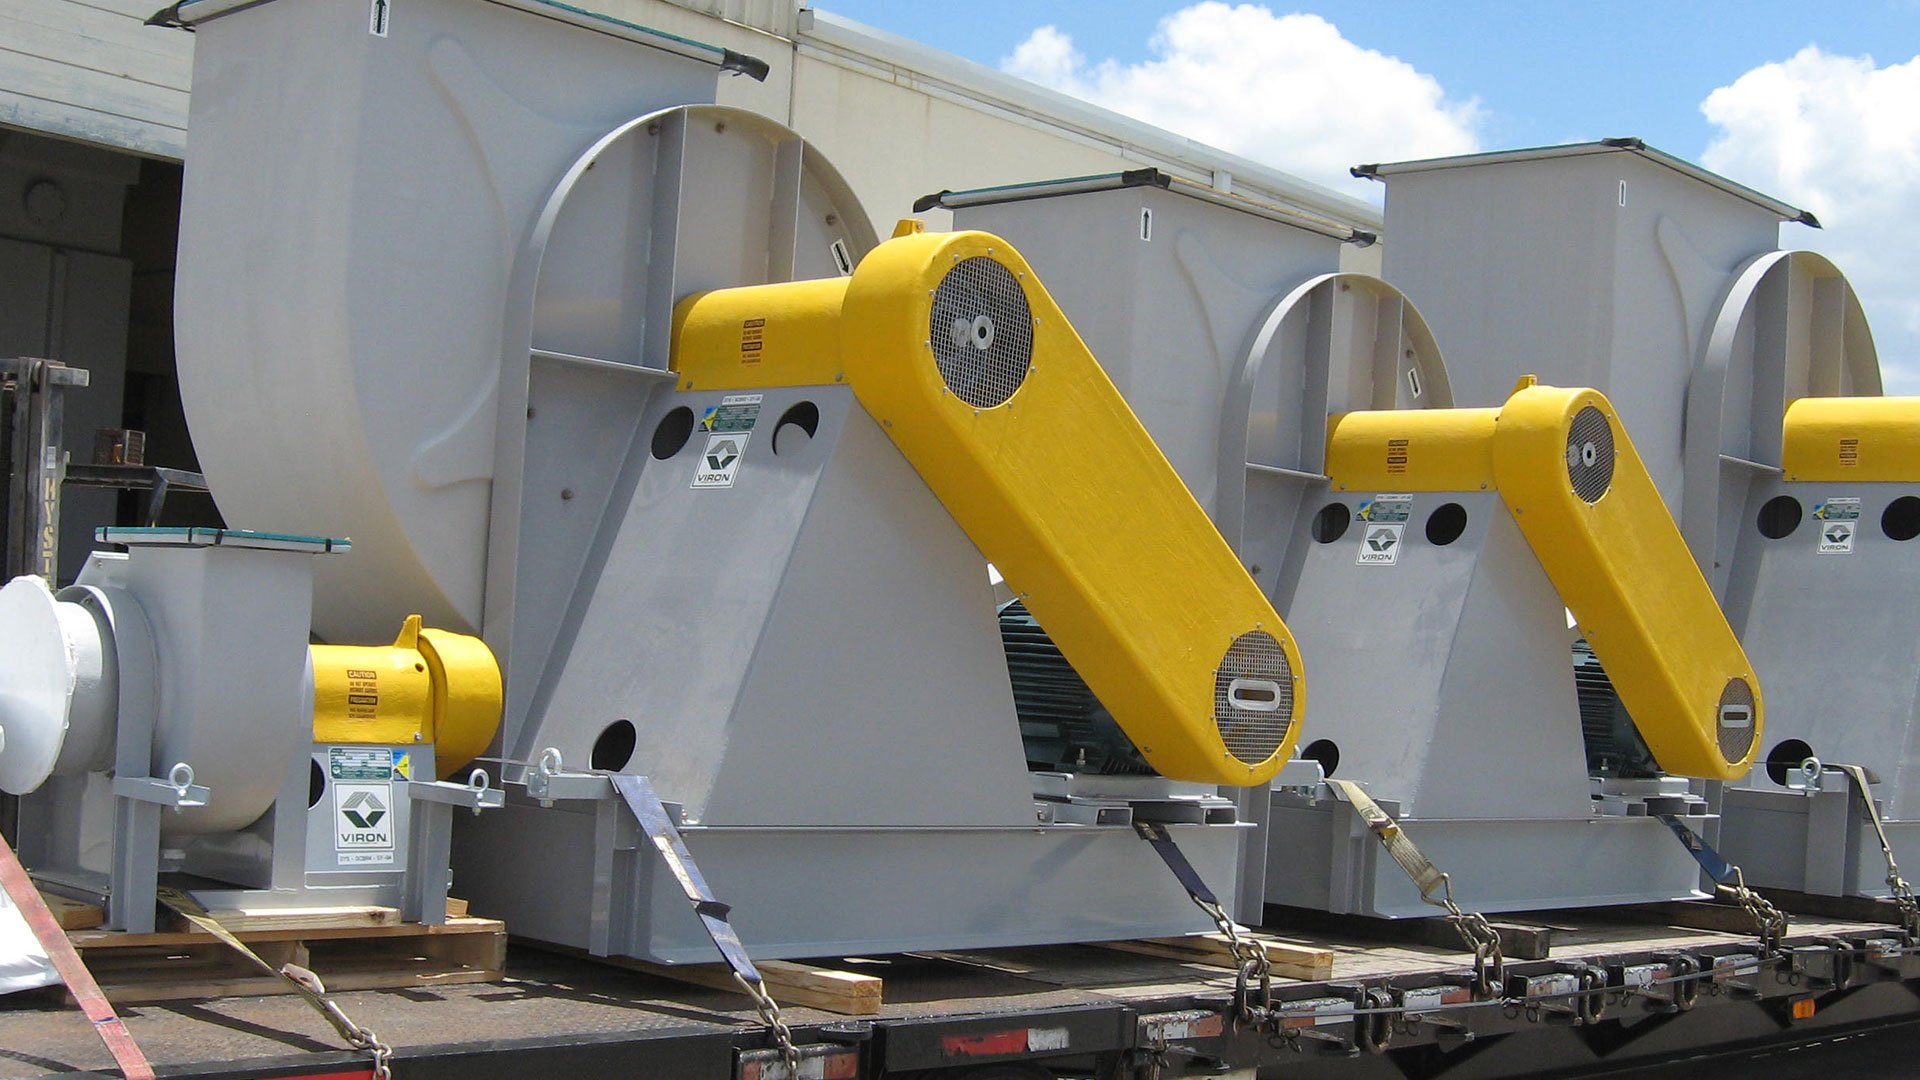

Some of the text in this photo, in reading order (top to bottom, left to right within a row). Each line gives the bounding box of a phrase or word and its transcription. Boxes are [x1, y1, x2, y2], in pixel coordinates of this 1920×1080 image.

[697, 473, 731, 482] VIRON
[348, 670, 376, 679] CAUTION
[340, 833, 387, 842] VIRON
